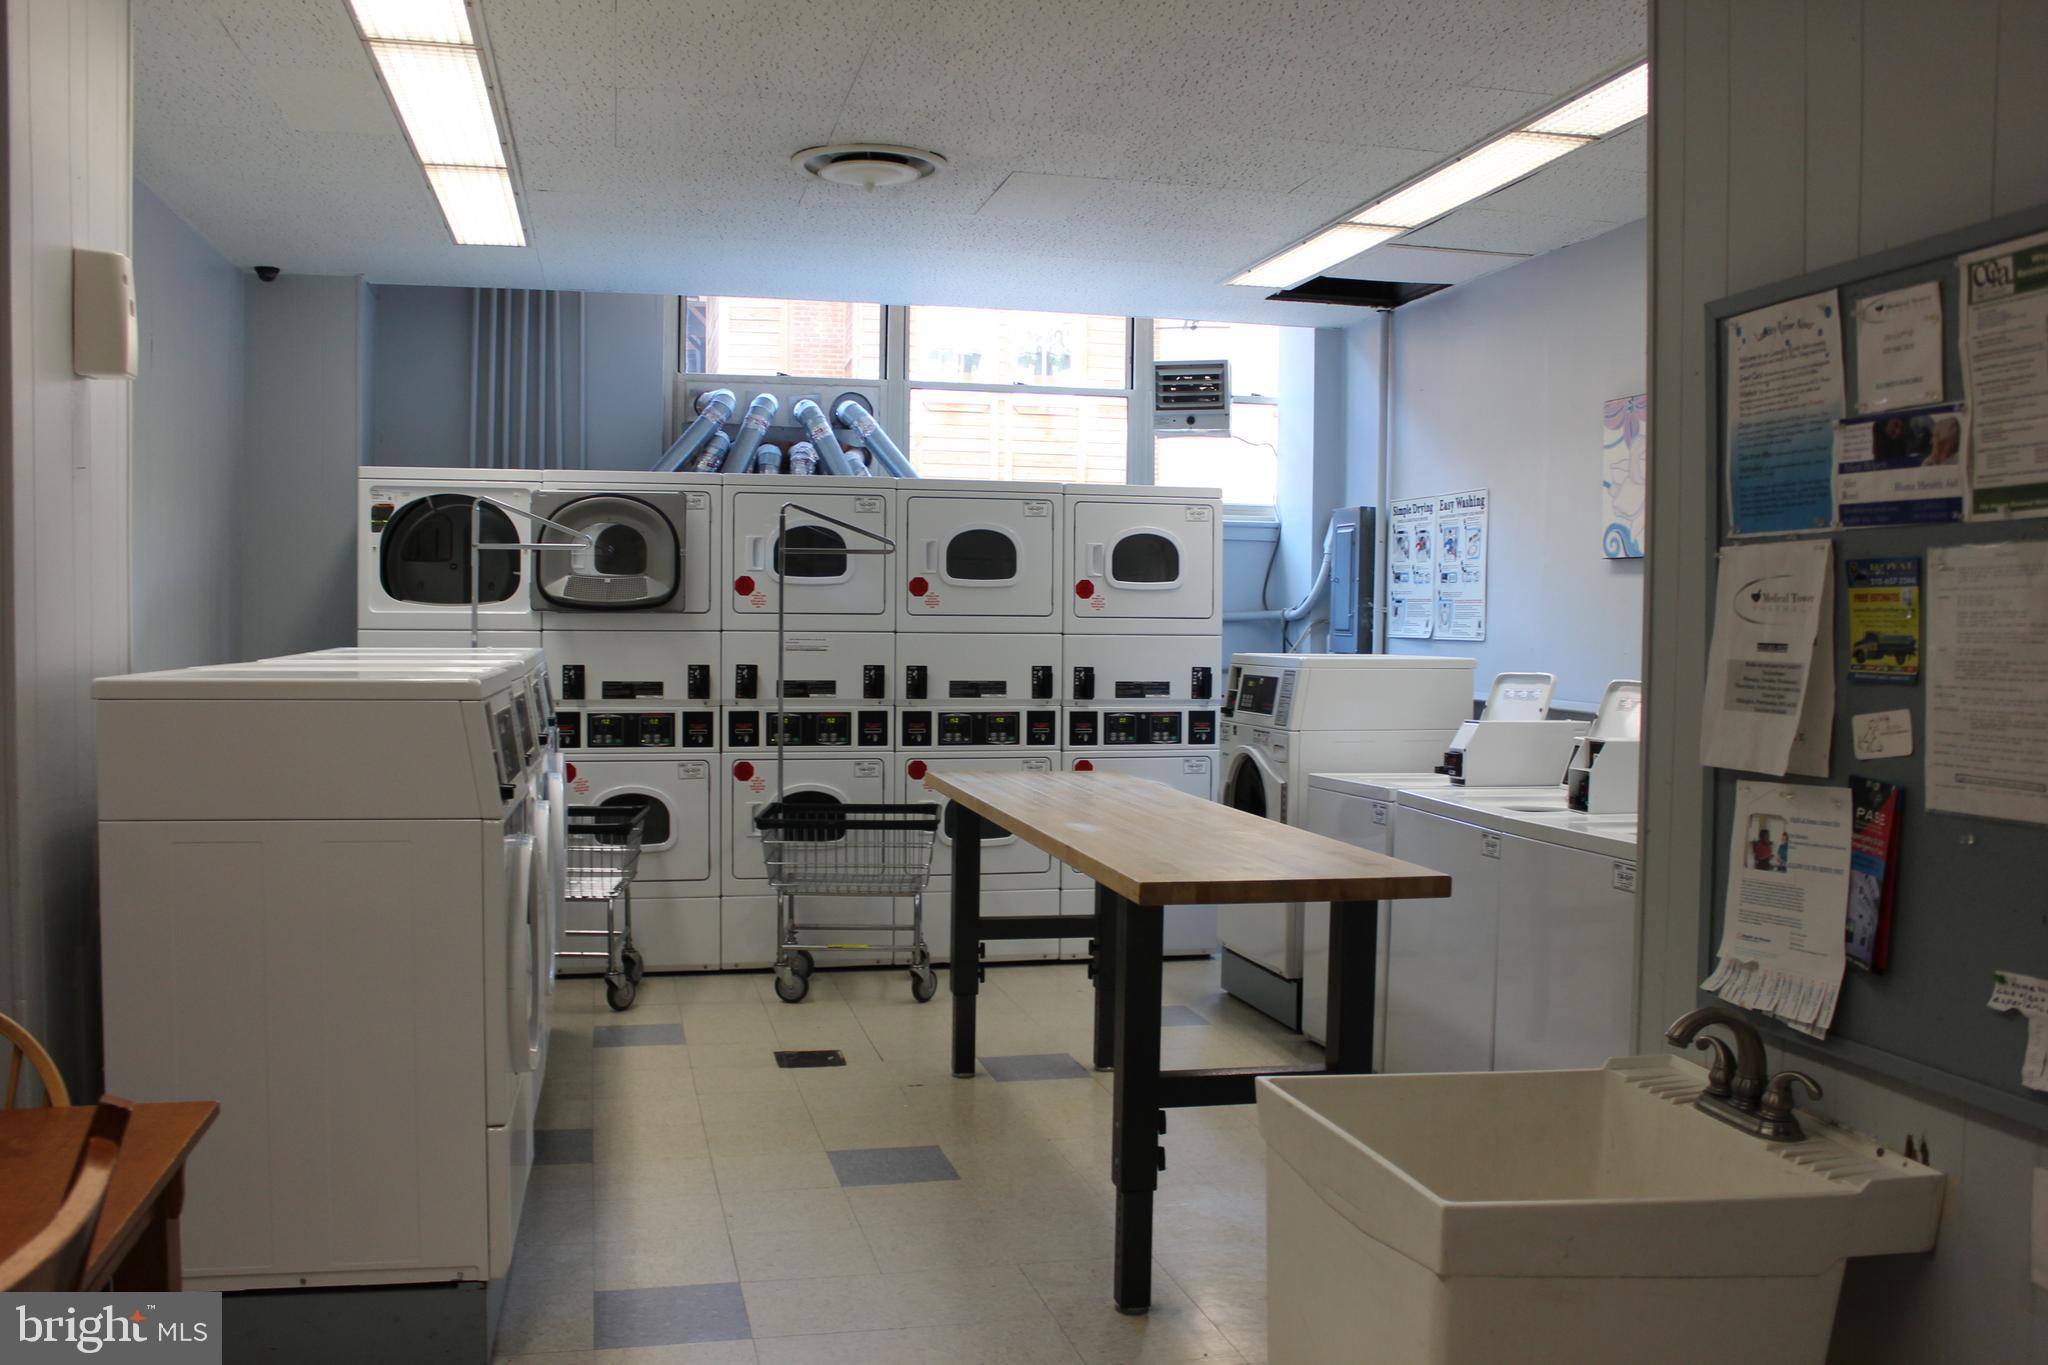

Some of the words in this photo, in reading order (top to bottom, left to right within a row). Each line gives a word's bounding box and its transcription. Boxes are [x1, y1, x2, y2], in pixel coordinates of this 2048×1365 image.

[1393, 504, 1411, 518] Simple
[1413, 503, 1433, 515] Drying
[1439, 500, 1454, 513] Easy
[1456, 496, 1485, 511] Washing
[1762, 592, 1789, 603] Medical
[1791, 592, 1814, 603] Tower
